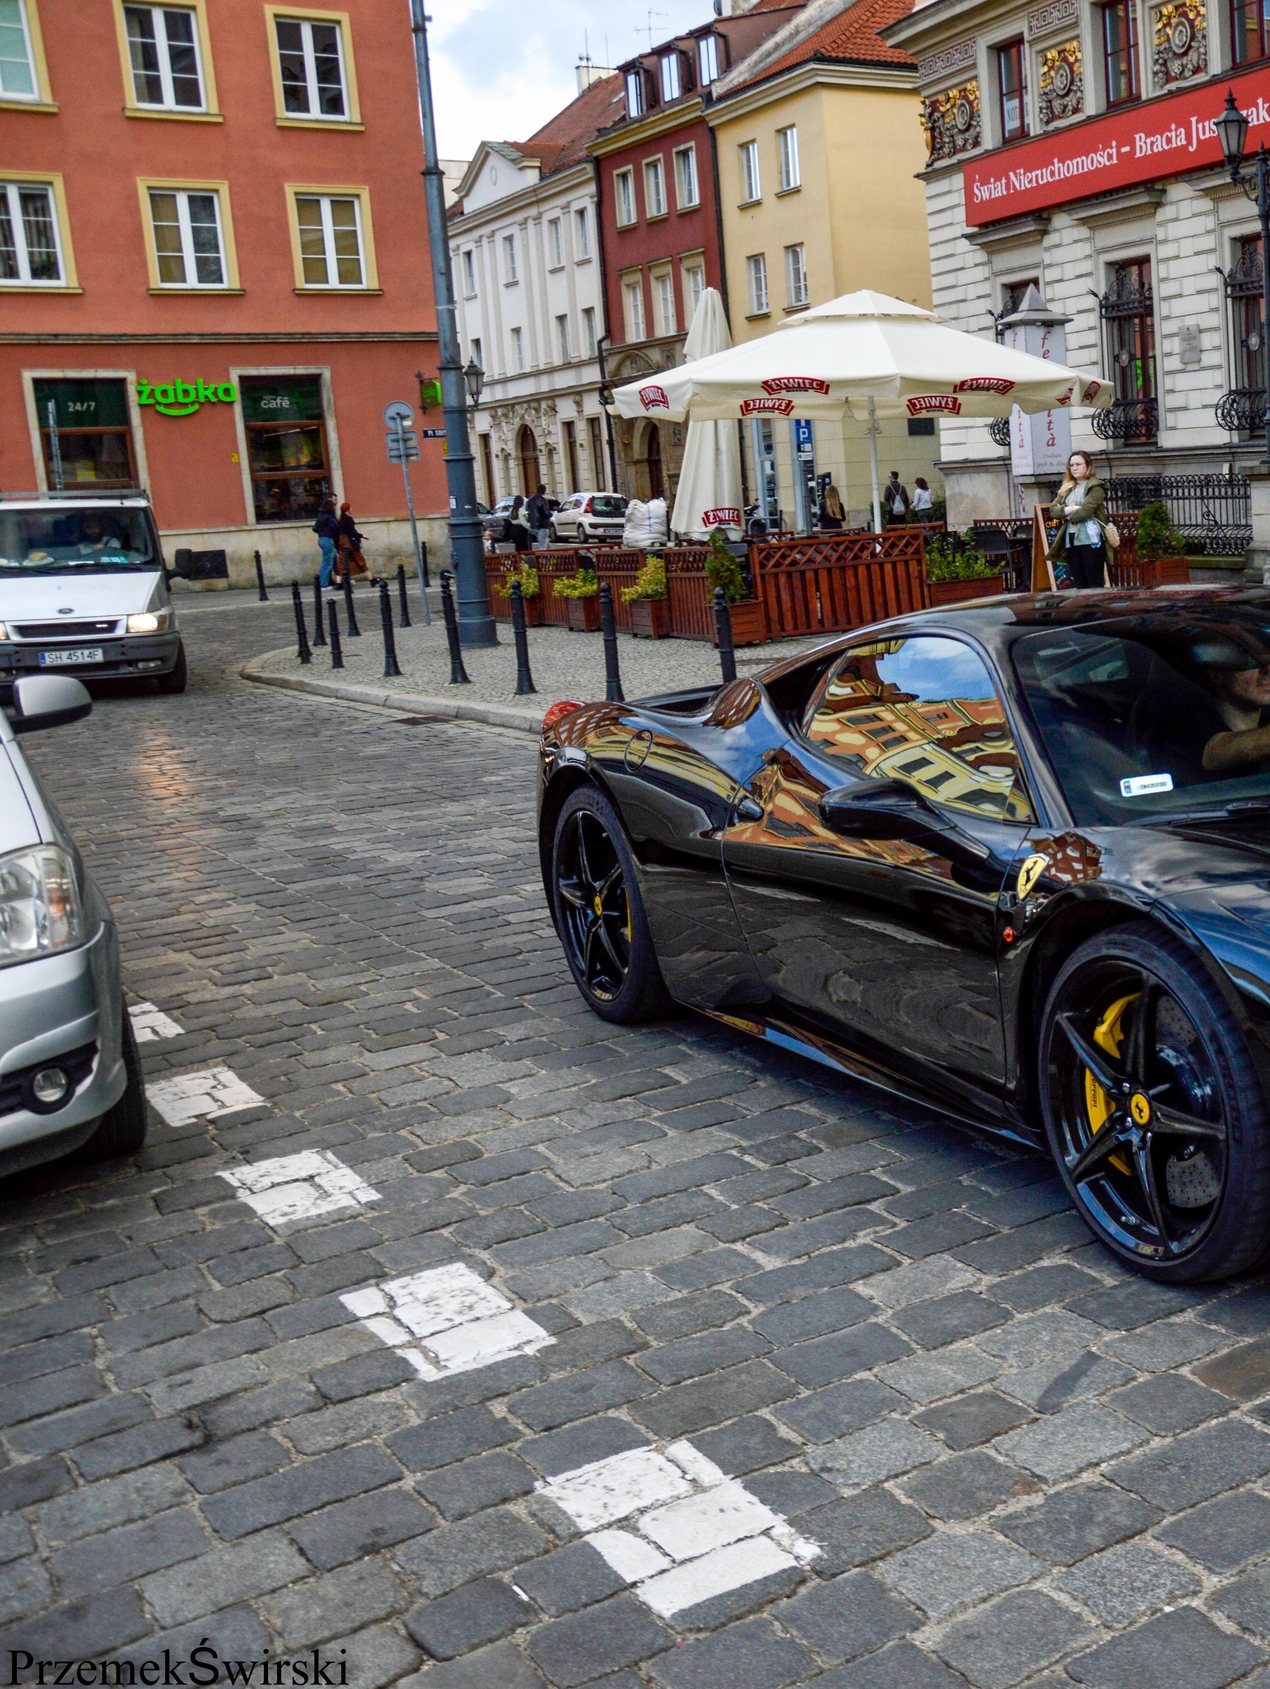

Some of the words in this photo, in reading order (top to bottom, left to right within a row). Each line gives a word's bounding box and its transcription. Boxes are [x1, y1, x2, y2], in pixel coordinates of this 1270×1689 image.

[973, 174, 1007, 203] Świat
[1009, 140, 1117, 193] Nieruchomości
[1134, 122, 1187, 158] Bracia
[768, 378, 821, 390] ŻYWIEC
[963, 379, 1010, 391] ŻYWIEC
[137, 378, 236, 406] żabka
[67, 401, 96, 412] 24/7
[47, 653, 63, 664] SH
[66, 649, 99, 661] 4514F
